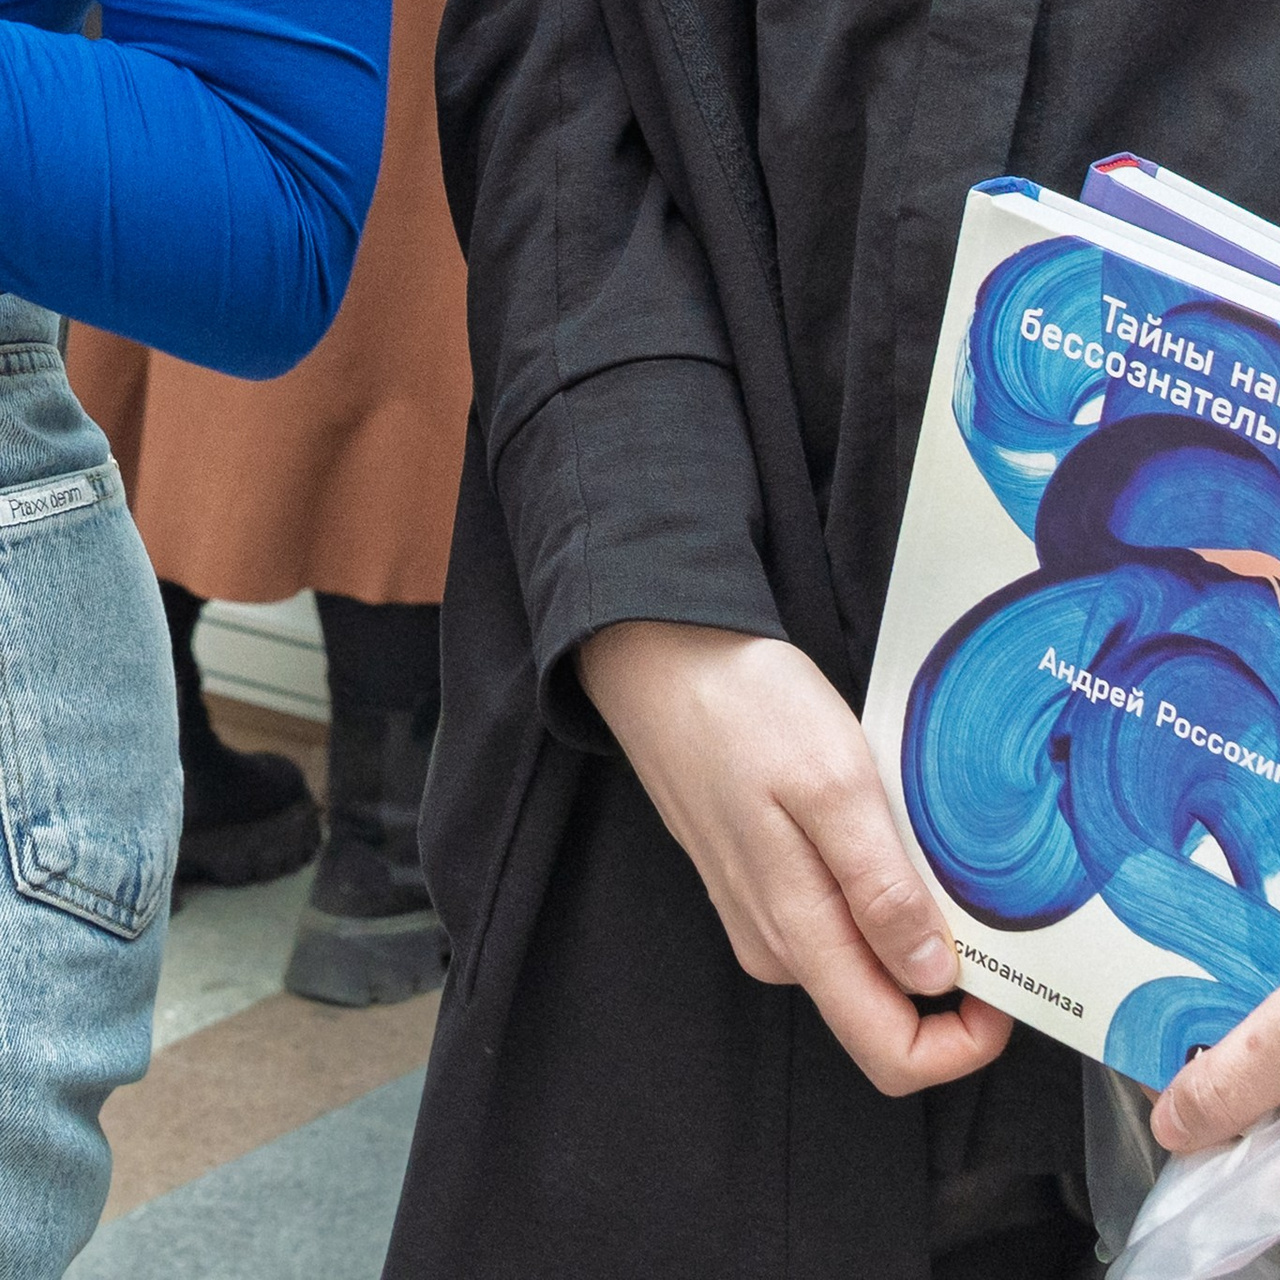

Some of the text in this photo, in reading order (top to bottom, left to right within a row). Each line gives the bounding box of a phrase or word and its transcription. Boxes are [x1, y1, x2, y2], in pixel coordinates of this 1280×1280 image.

[1102, 295, 1214, 376] Тайны
[1037, 646, 1144, 717] Андрей
[954, 939, 1084, 1019] сихоанализа
